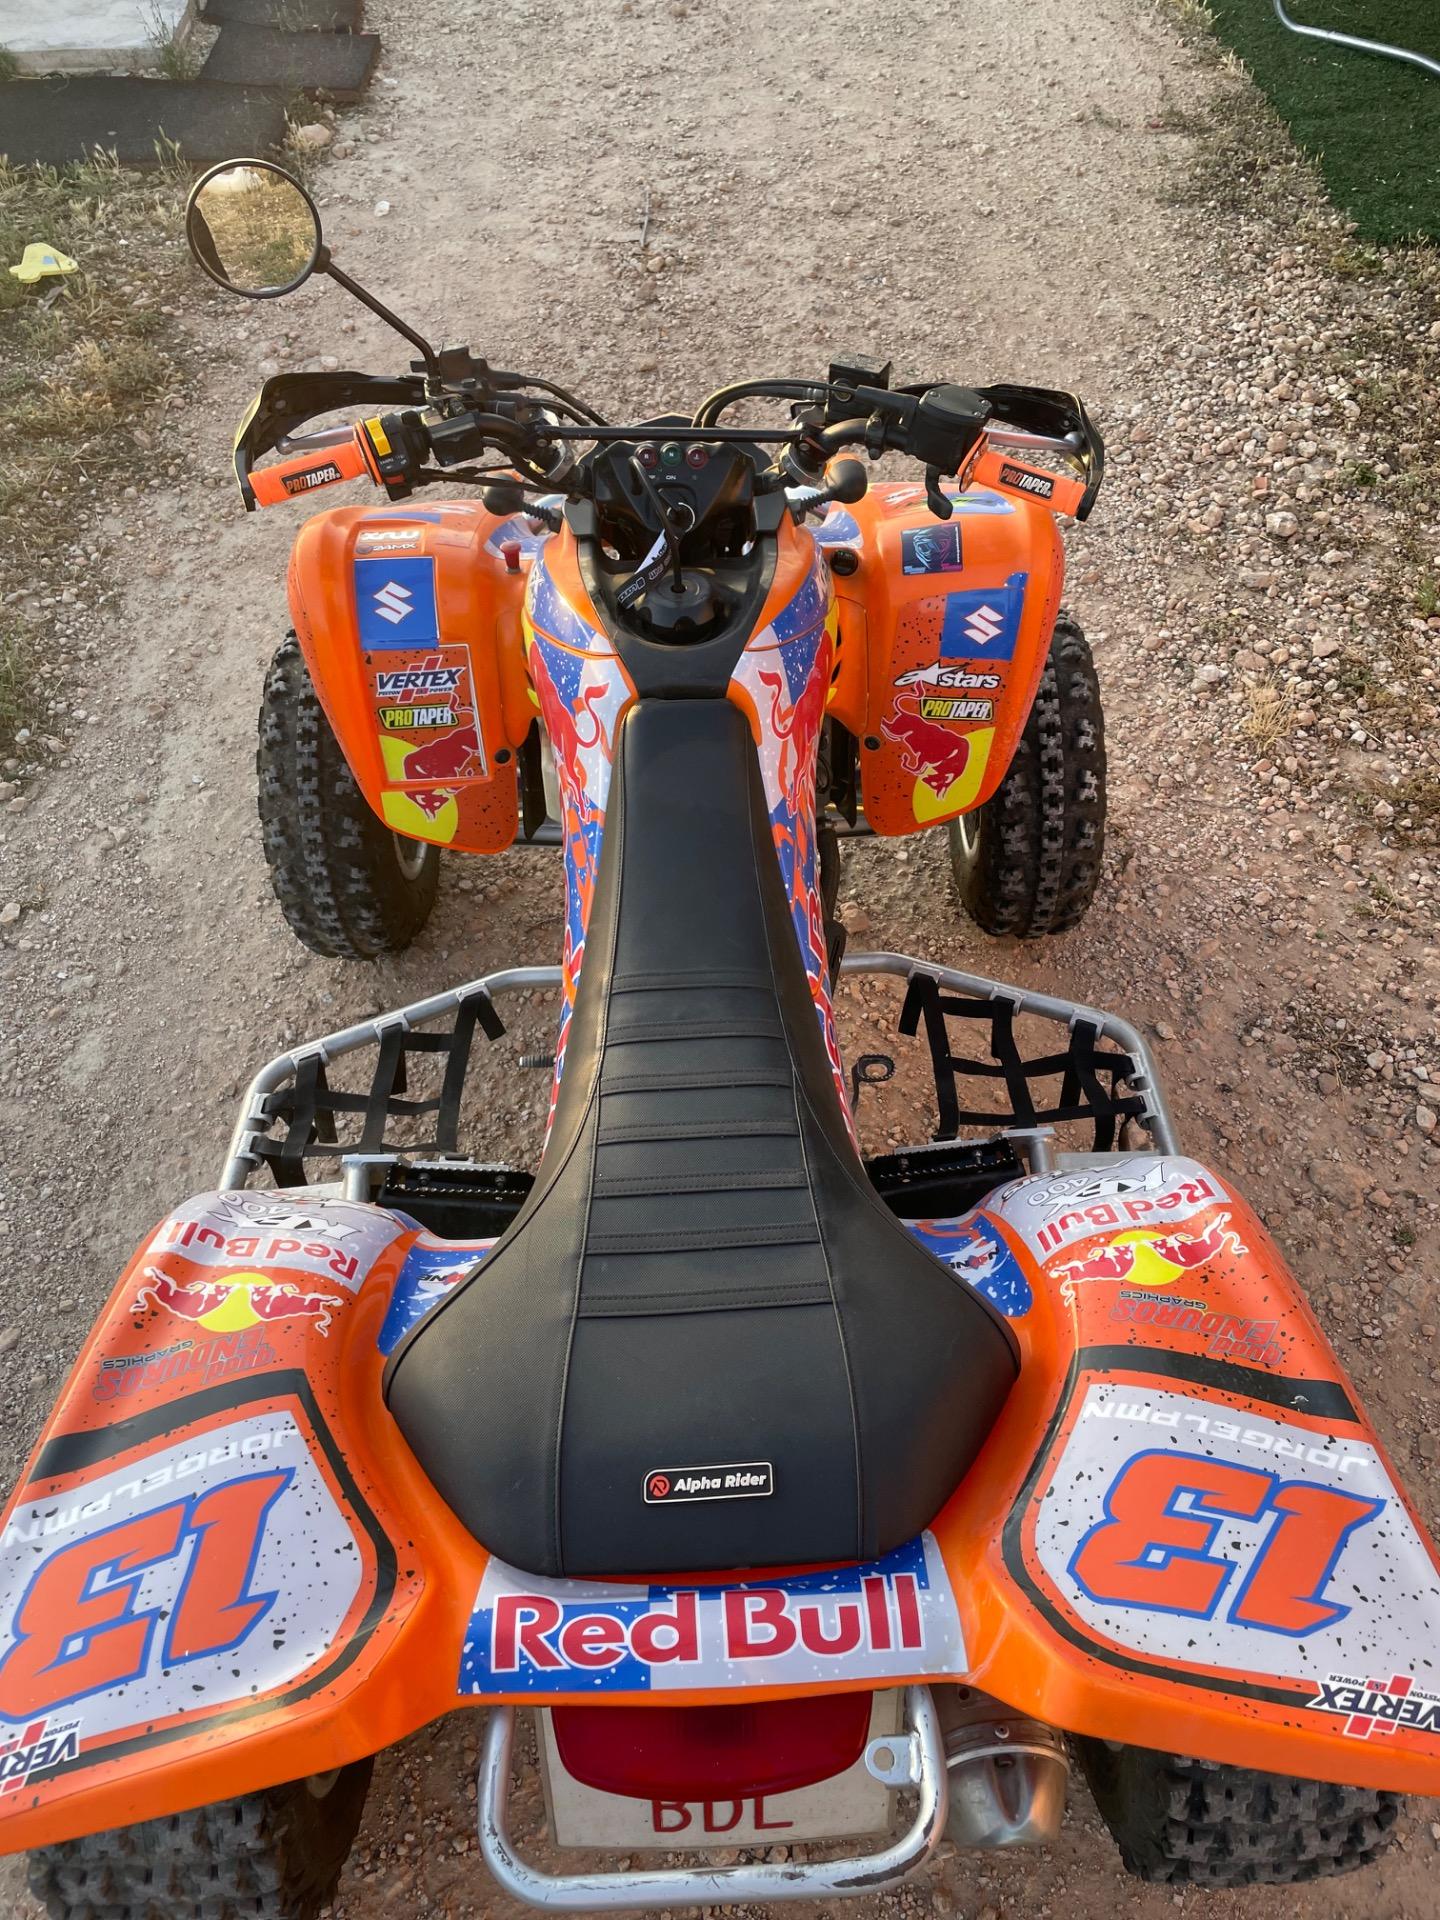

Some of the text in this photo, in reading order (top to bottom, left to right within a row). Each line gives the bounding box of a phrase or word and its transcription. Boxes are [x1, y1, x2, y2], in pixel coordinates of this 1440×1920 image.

[378, 667, 464, 691] VERTEX
[385, 706, 452, 729] PROTAPER
[925, 700, 990, 720] PROTAPER
[1027, 1176, 1090, 1206] 400
[1036, 1178, 1216, 1253] Red Bull
[167, 1222, 360, 1281] Red Bull
[1120, 1290, 1207, 1310] GRAPHICS
[1110, 1300, 1279, 1345] ENDUROS
[92, 1326, 266, 1400] ENDUROS
[102, 1340, 193, 1369] GRAPHICS
[674, 1473, 767, 1493] Alpha Rider
[1066, 1448, 1387, 1639] 13
[0, 1466, 297, 1723] 13
[491, 1572, 924, 1674] Red Bull
[1312, 1683, 1440, 1730] VERTEX
[651, 1796, 794, 1833] BDL
